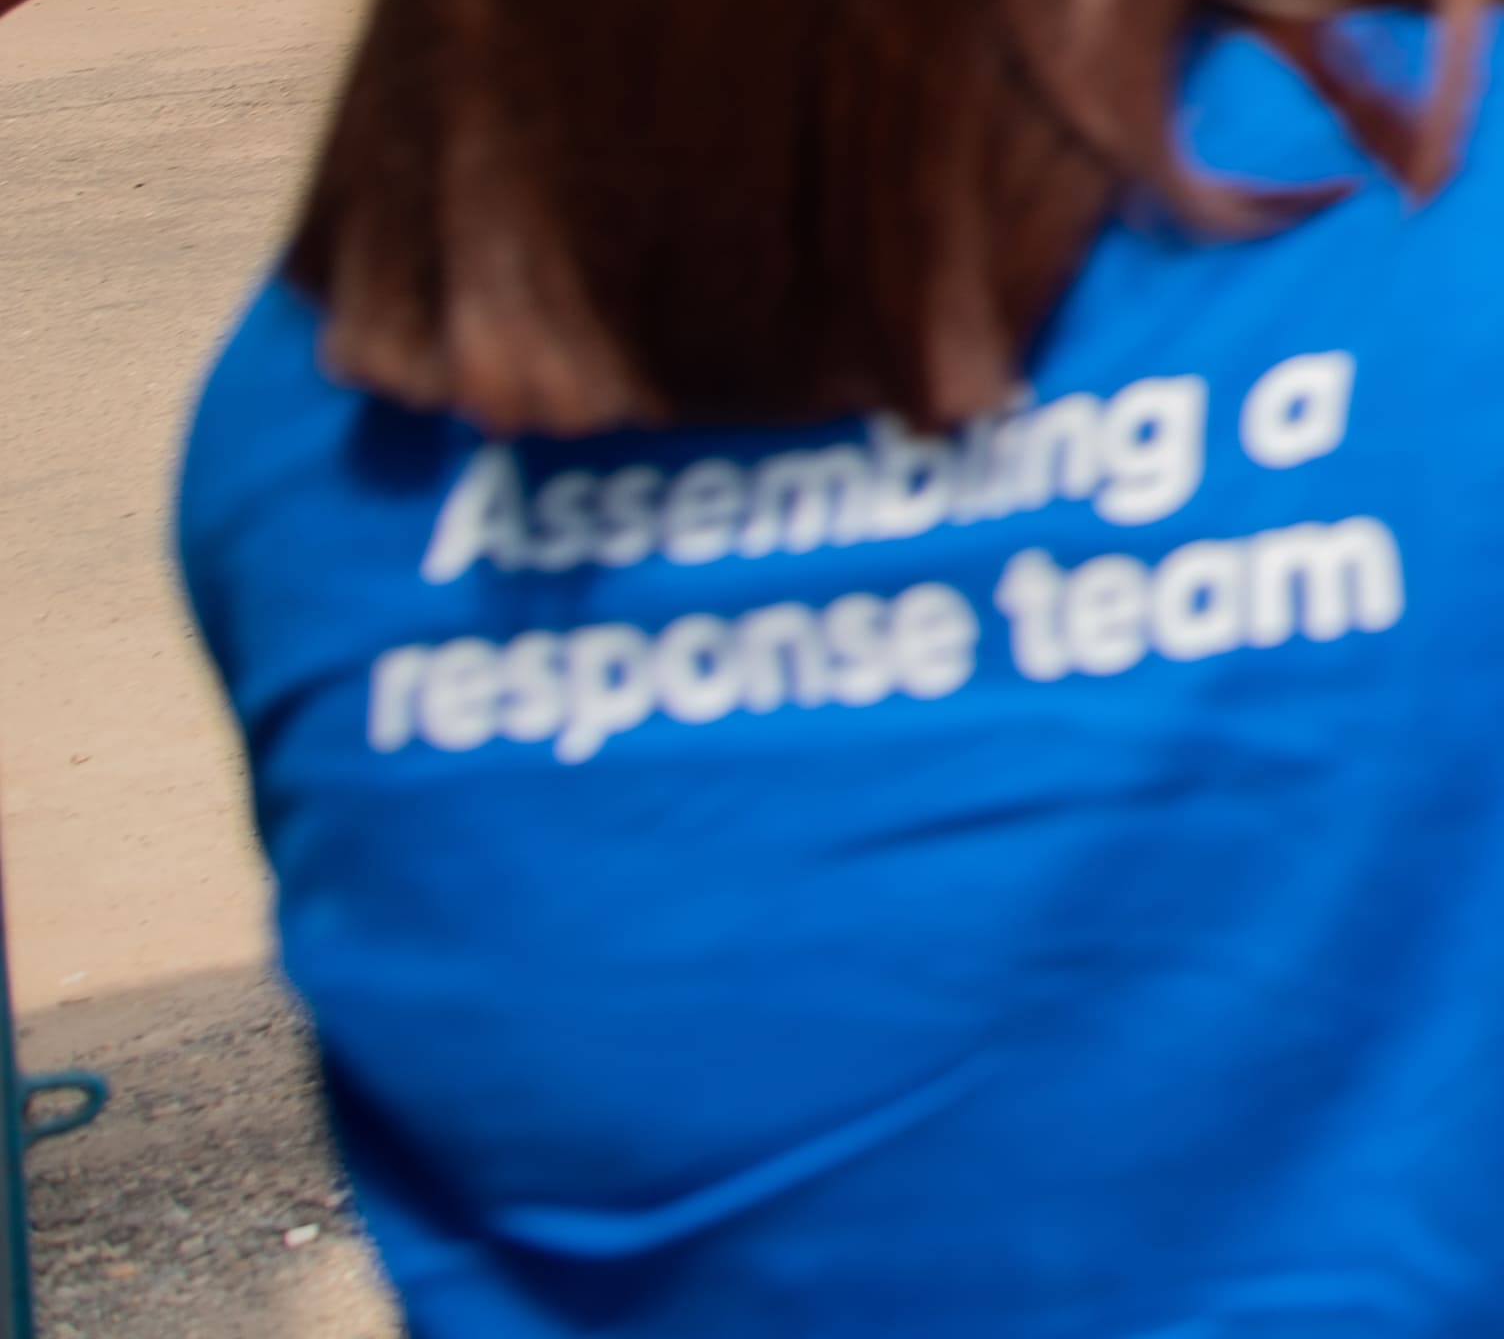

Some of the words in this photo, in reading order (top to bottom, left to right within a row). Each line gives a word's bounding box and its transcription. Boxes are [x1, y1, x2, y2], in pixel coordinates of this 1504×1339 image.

[1239, 350, 1357, 470] a
[367, 581, 979, 765] response
[995, 515, 1404, 683] team
